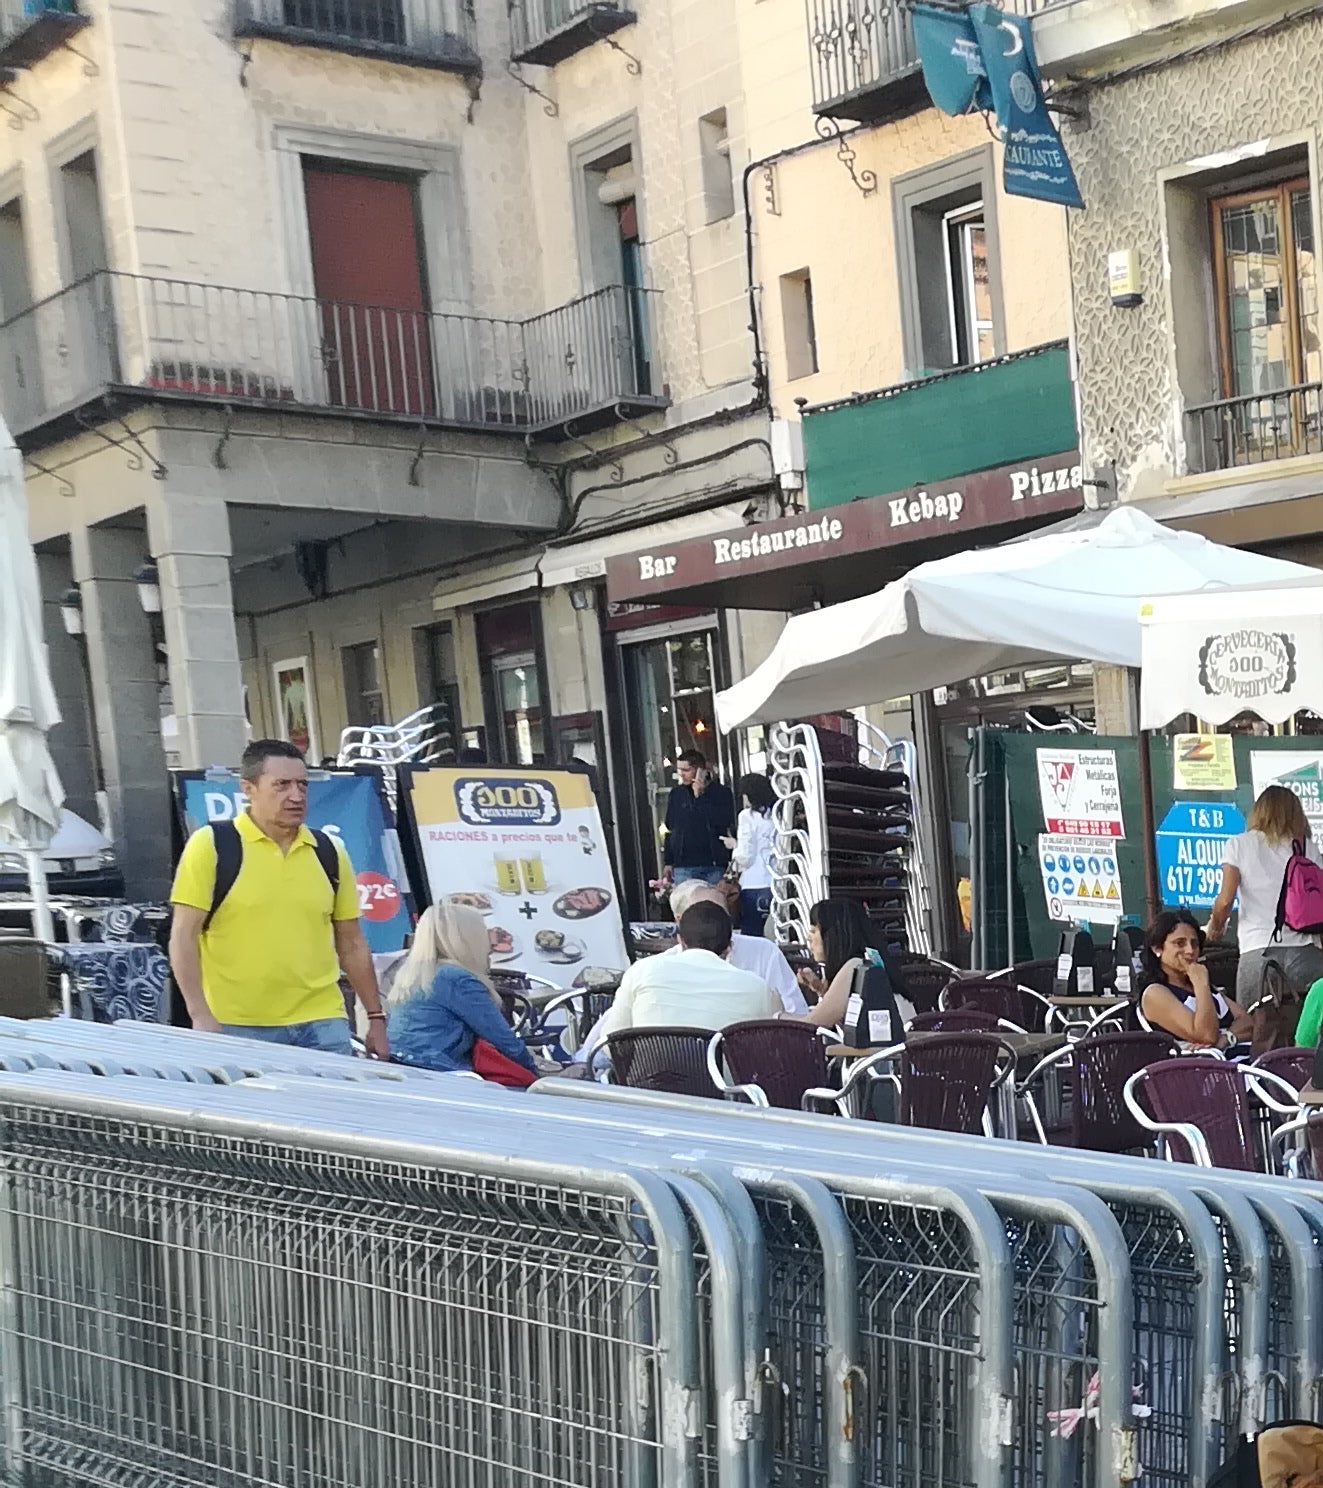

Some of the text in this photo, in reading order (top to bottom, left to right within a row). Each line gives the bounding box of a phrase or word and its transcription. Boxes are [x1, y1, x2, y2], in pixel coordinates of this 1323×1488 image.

[638, 554, 677, 582] Bar
[713, 515, 843, 565] Restaurante
[888, 488, 963, 528] Kebap
[1010, 464, 1082, 501] Pizza
[1209, 665, 1285, 699] MONTADITOS
[429, 831, 578, 844] RACIONES a precios que te
[1167, 865, 1193, 893] 617
